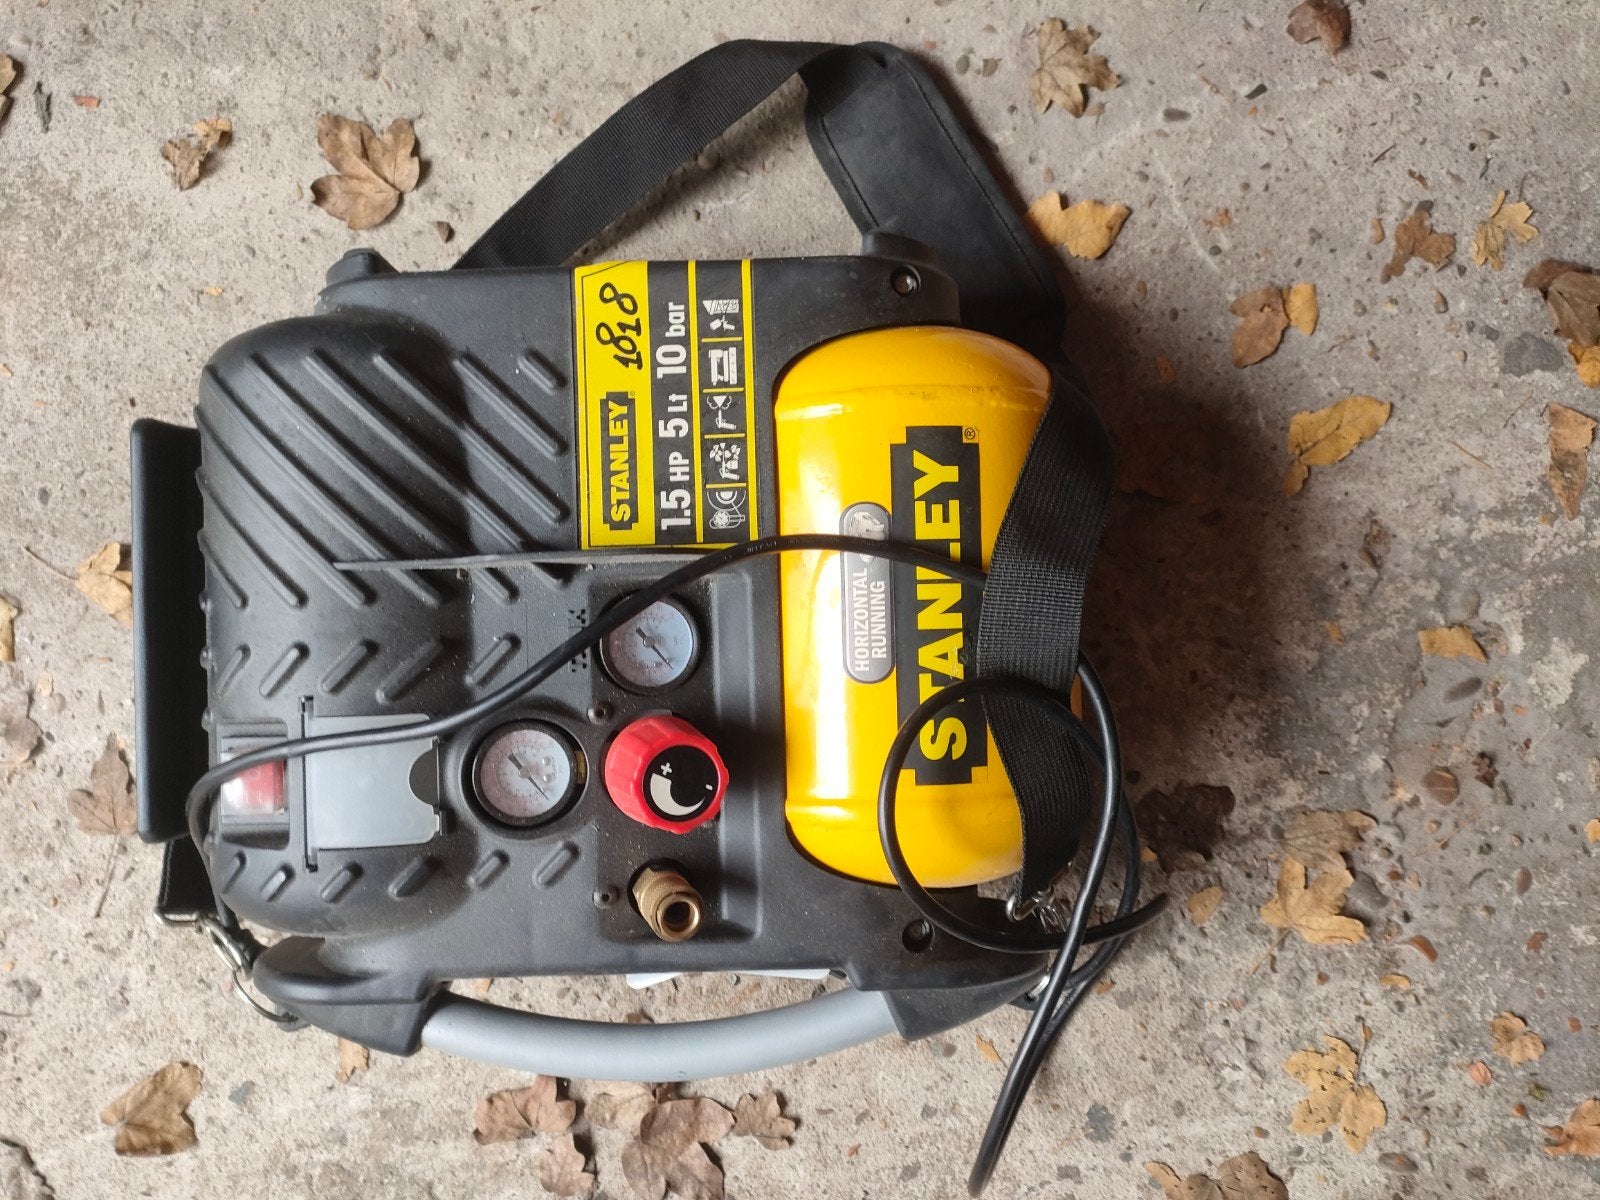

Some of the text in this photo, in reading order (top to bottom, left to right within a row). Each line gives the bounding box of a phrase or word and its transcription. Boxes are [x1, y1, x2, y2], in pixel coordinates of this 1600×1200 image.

[609, 400, 632, 522] STANLEY
[655, 302, 692, 531] 1.5 HP 5 Lt 10 bar
[853, 567, 870, 673] HORIZONTAL
[869, 580, 887, 659] RUNNING
